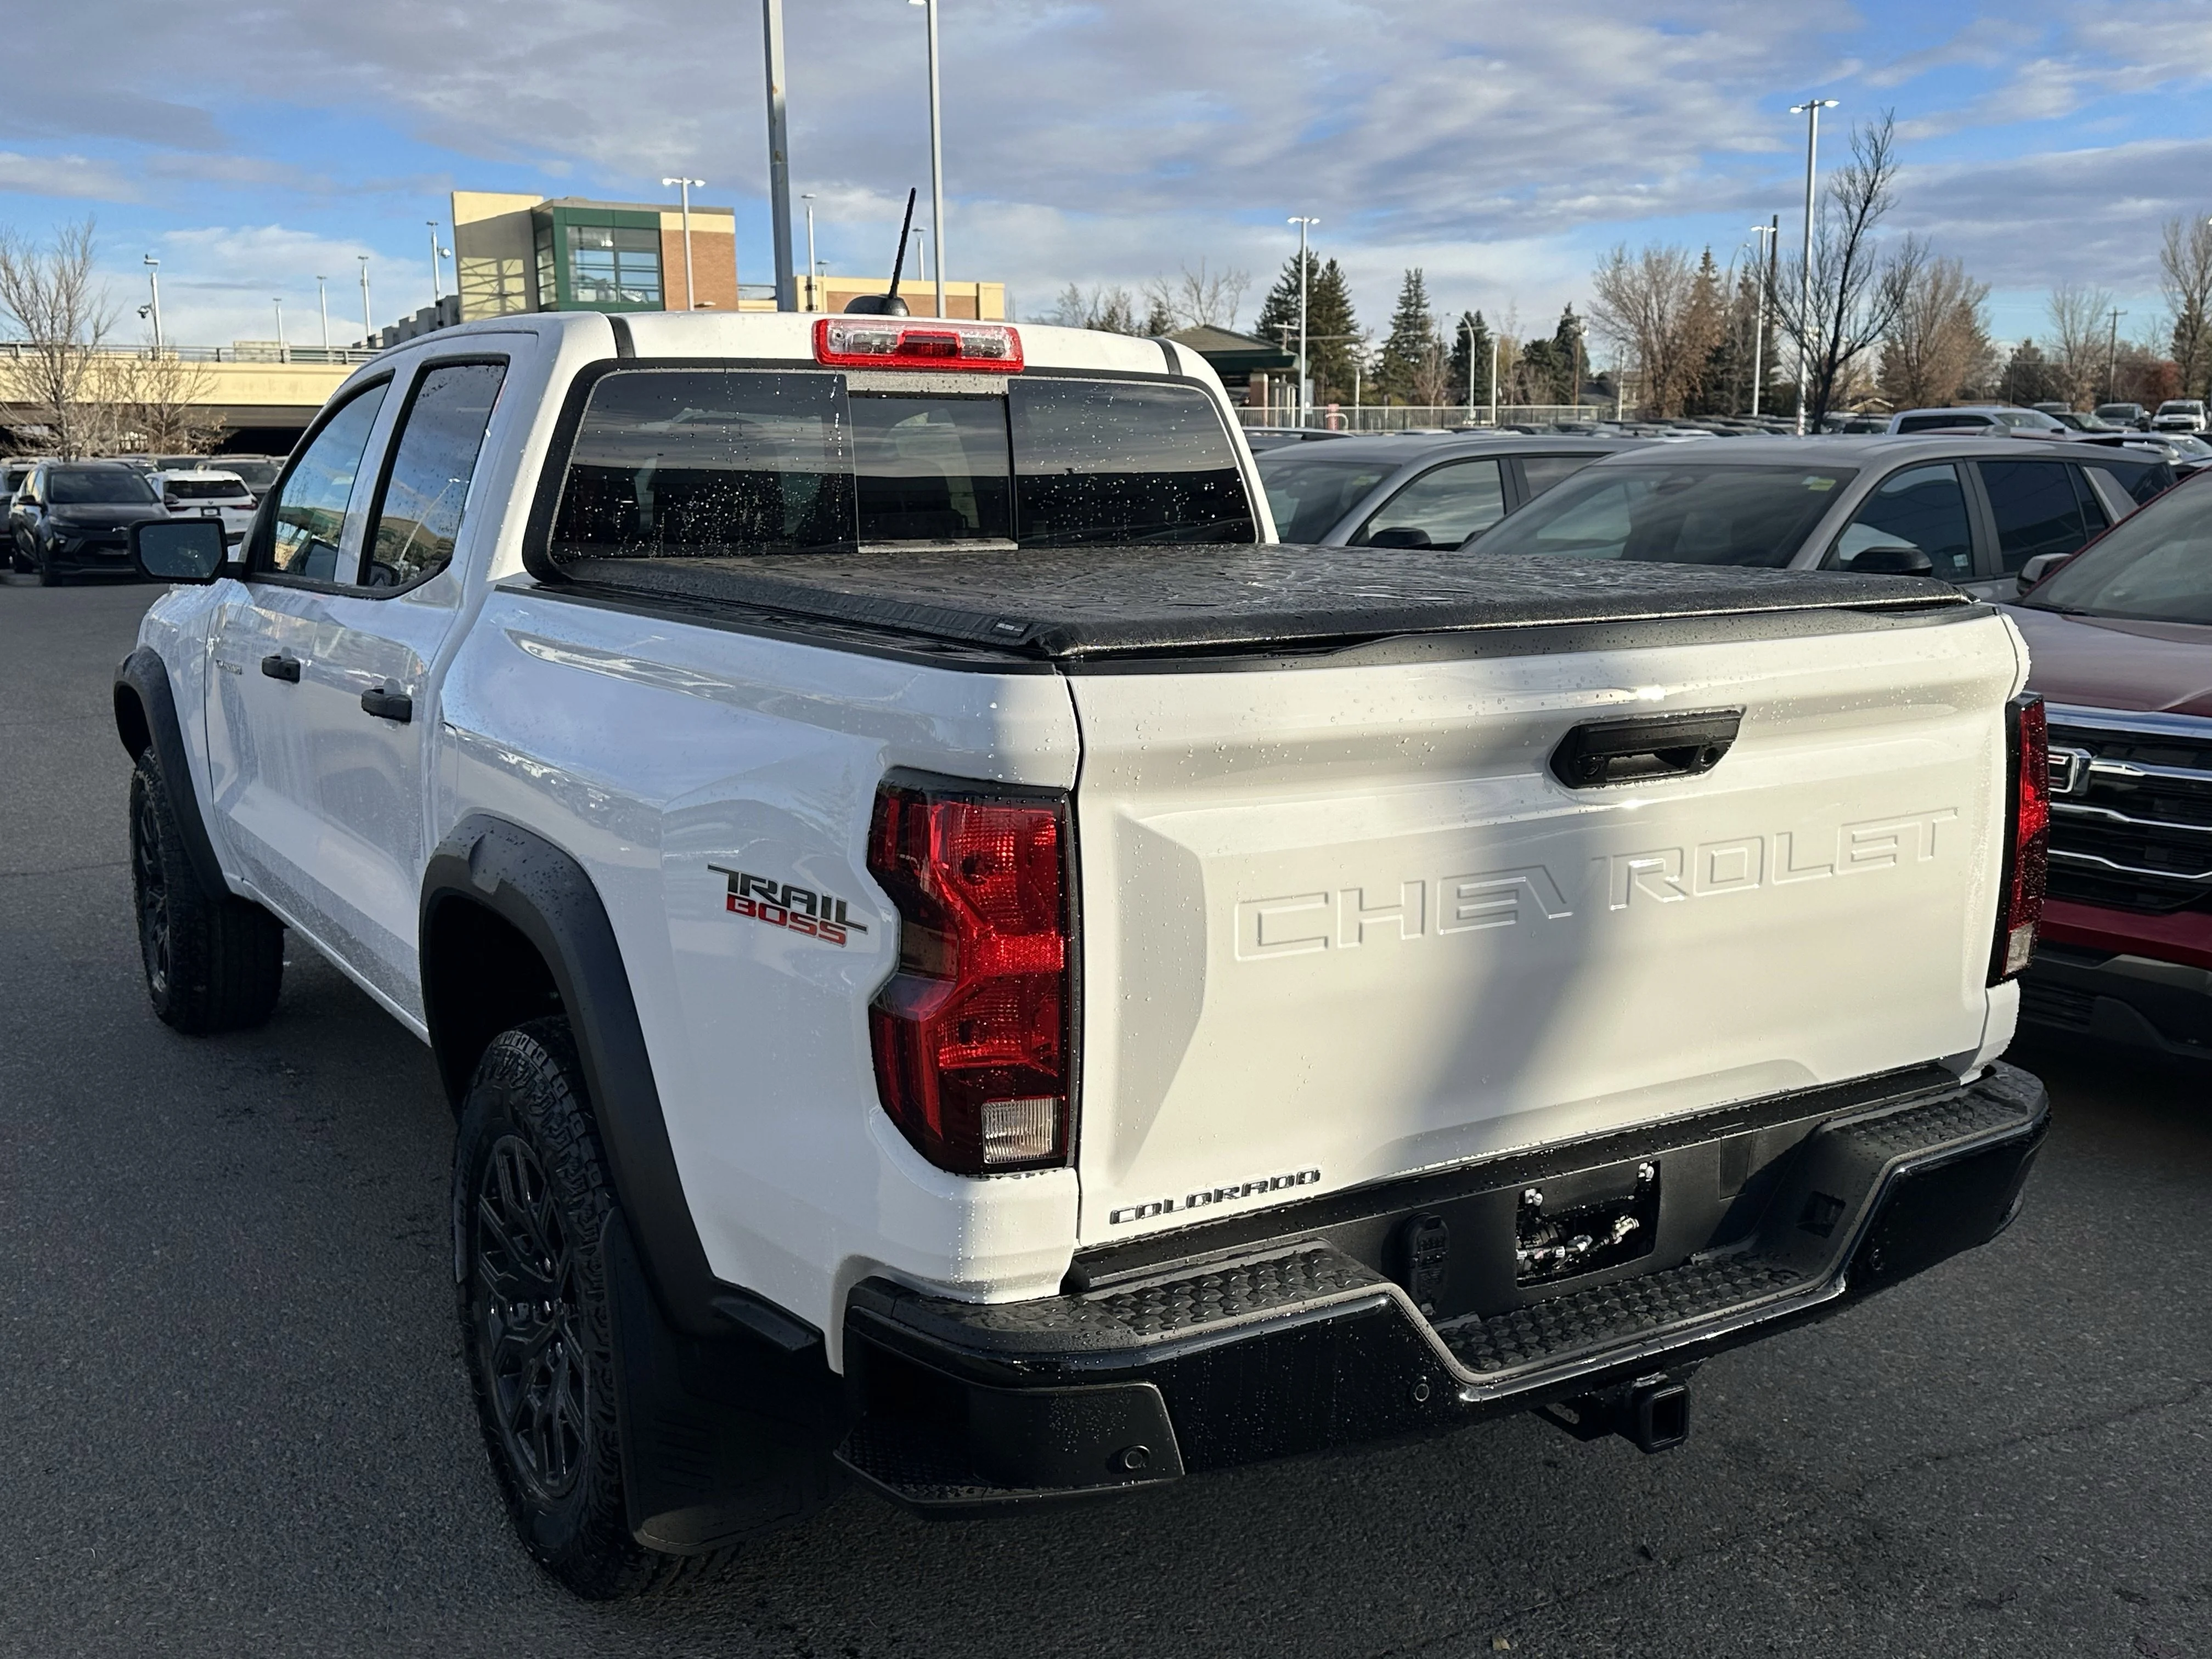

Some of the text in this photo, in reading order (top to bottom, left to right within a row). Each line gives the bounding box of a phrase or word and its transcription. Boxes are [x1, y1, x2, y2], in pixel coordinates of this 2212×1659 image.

[708, 864, 868, 933] TRAIL
[1236, 807, 1959, 961] CHEVROLET
[726, 893, 847, 946] BOSS
[1109, 1167, 1322, 1225] COLORADO
